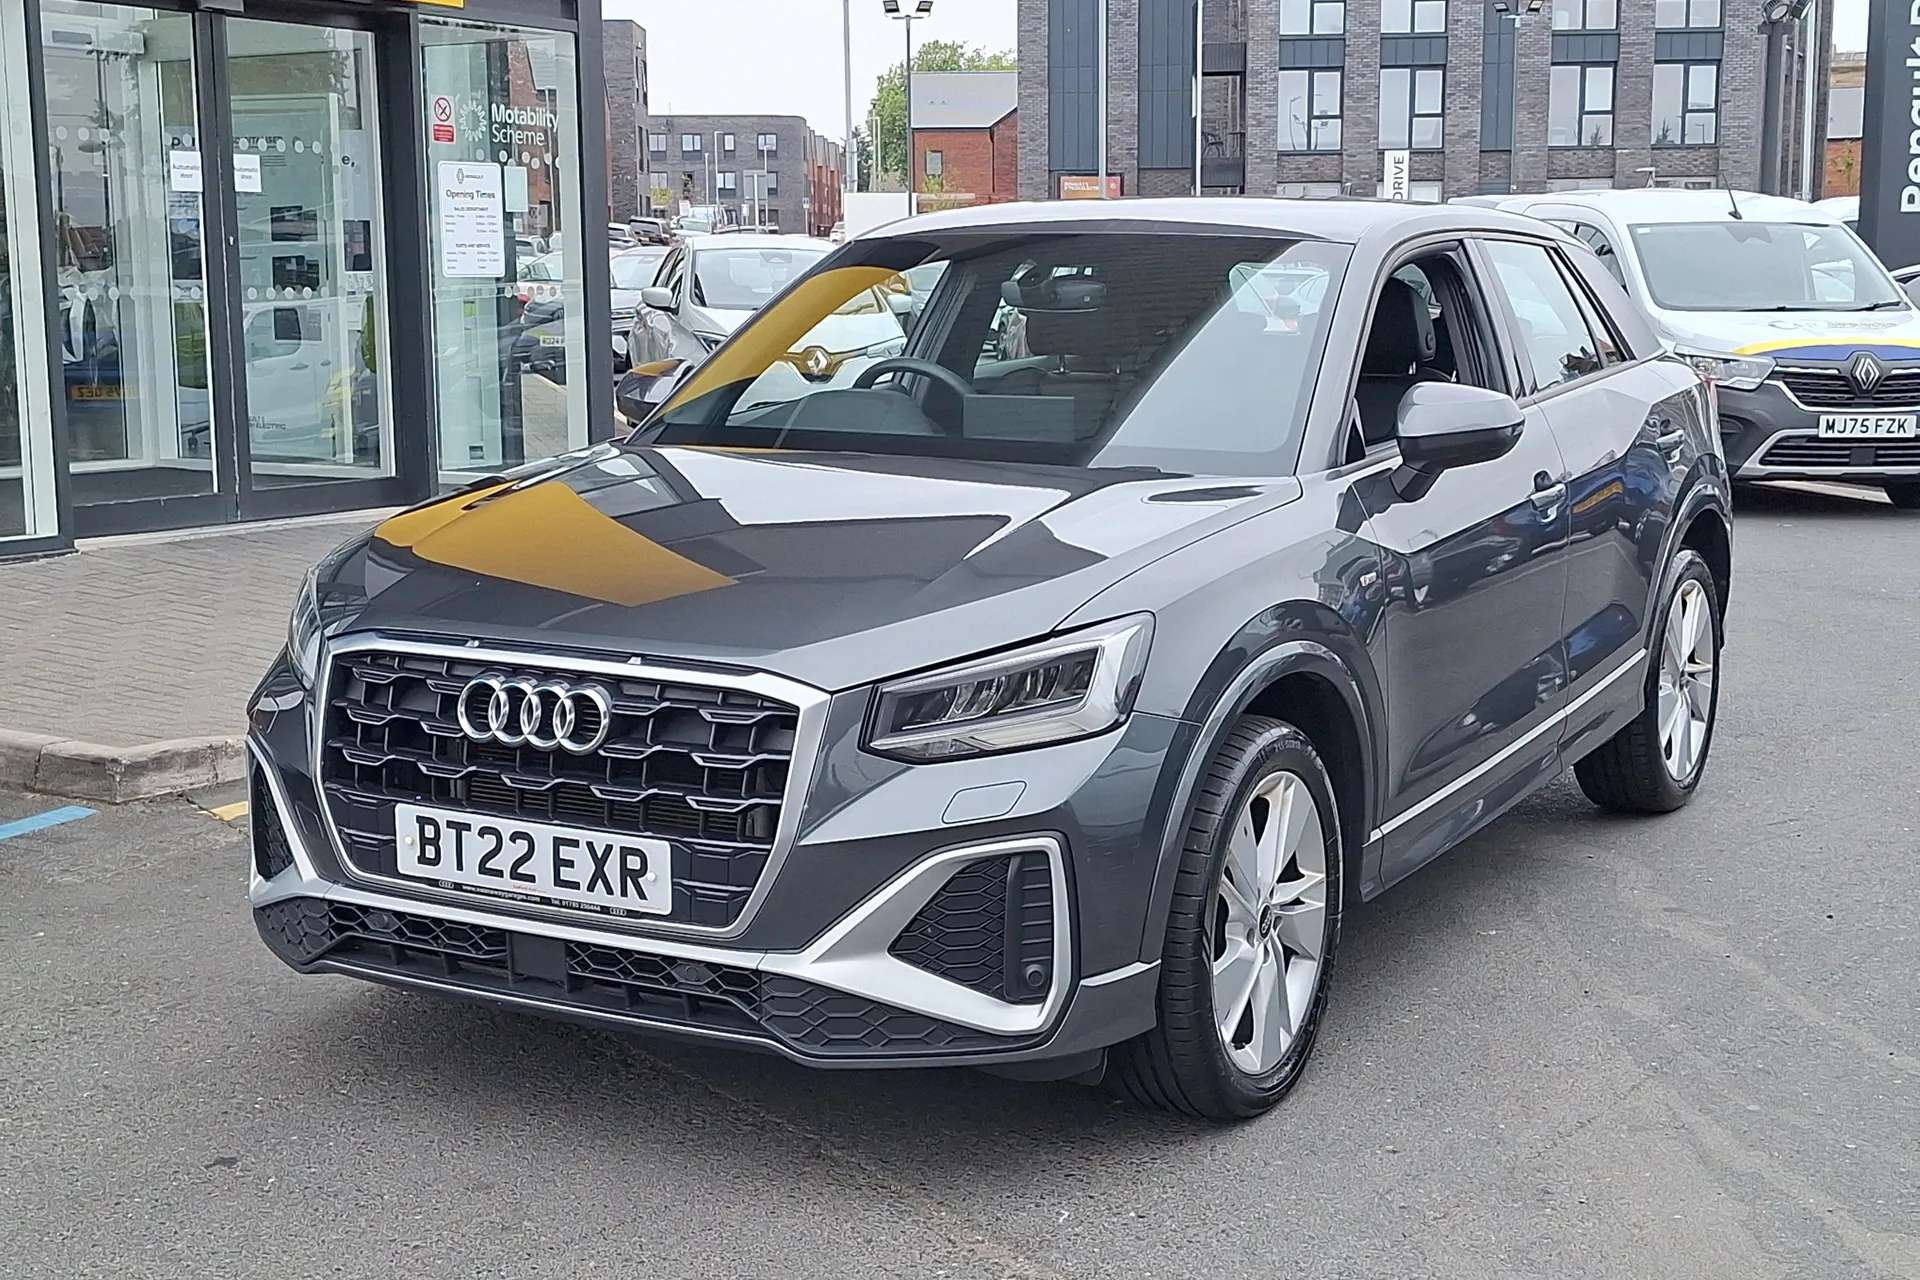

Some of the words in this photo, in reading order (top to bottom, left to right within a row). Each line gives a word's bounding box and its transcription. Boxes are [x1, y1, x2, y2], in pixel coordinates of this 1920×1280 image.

[491, 103, 560, 133] Motability
[492, 124, 545, 146] Scheme
[1392, 155, 1405, 200] DRIVE
[446, 189, 474, 200] Opening
[475, 190, 496, 199] Times
[1825, 418, 1869, 434] MJ75
[1874, 418, 1908, 434] FZK
[415, 814, 537, 884] BT22
[552, 835, 649, 901] EXR
